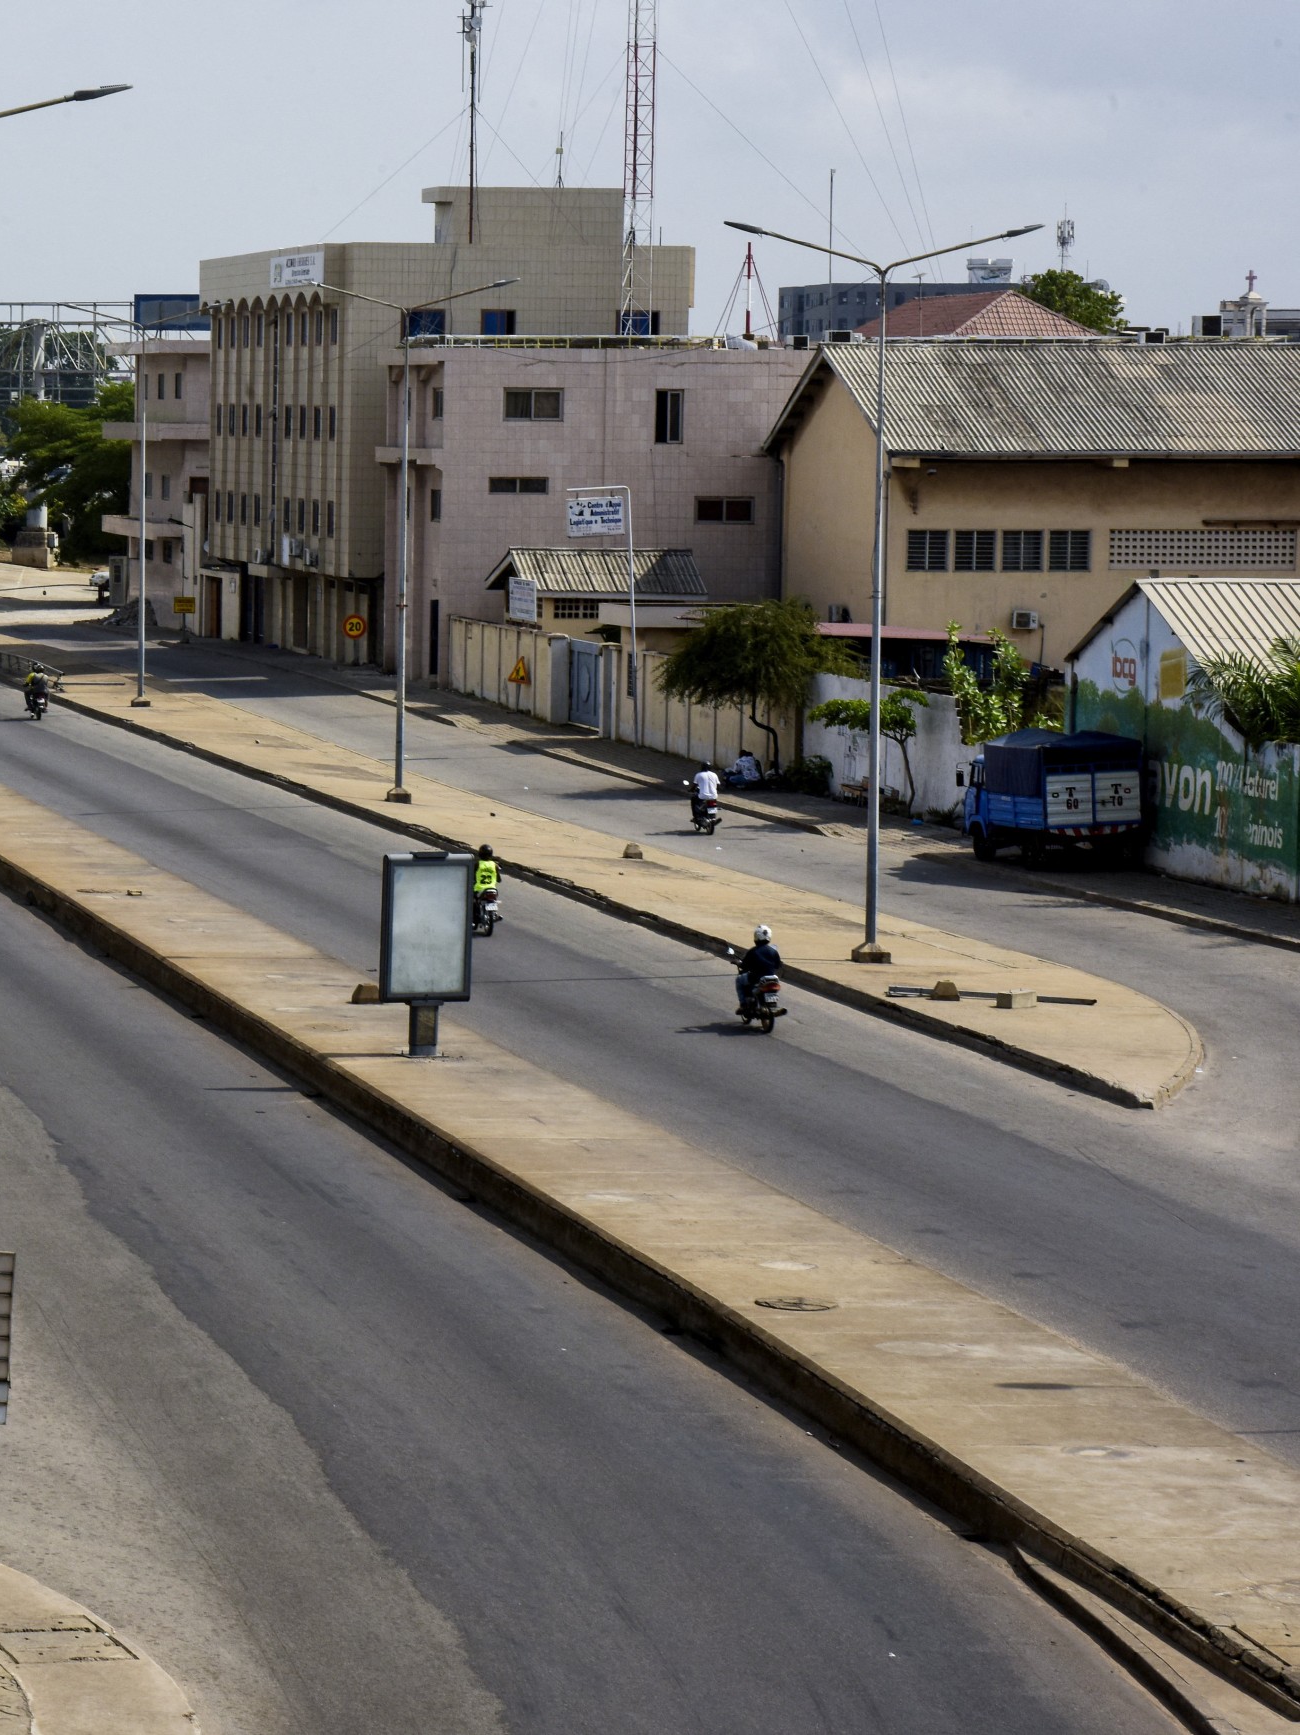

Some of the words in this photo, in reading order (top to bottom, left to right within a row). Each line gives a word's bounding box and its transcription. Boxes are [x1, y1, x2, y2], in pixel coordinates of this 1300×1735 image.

[348, 621, 361, 632] 20
[1066, 798, 1079, 810] 60
[1109, 795, 1123, 807] 70
